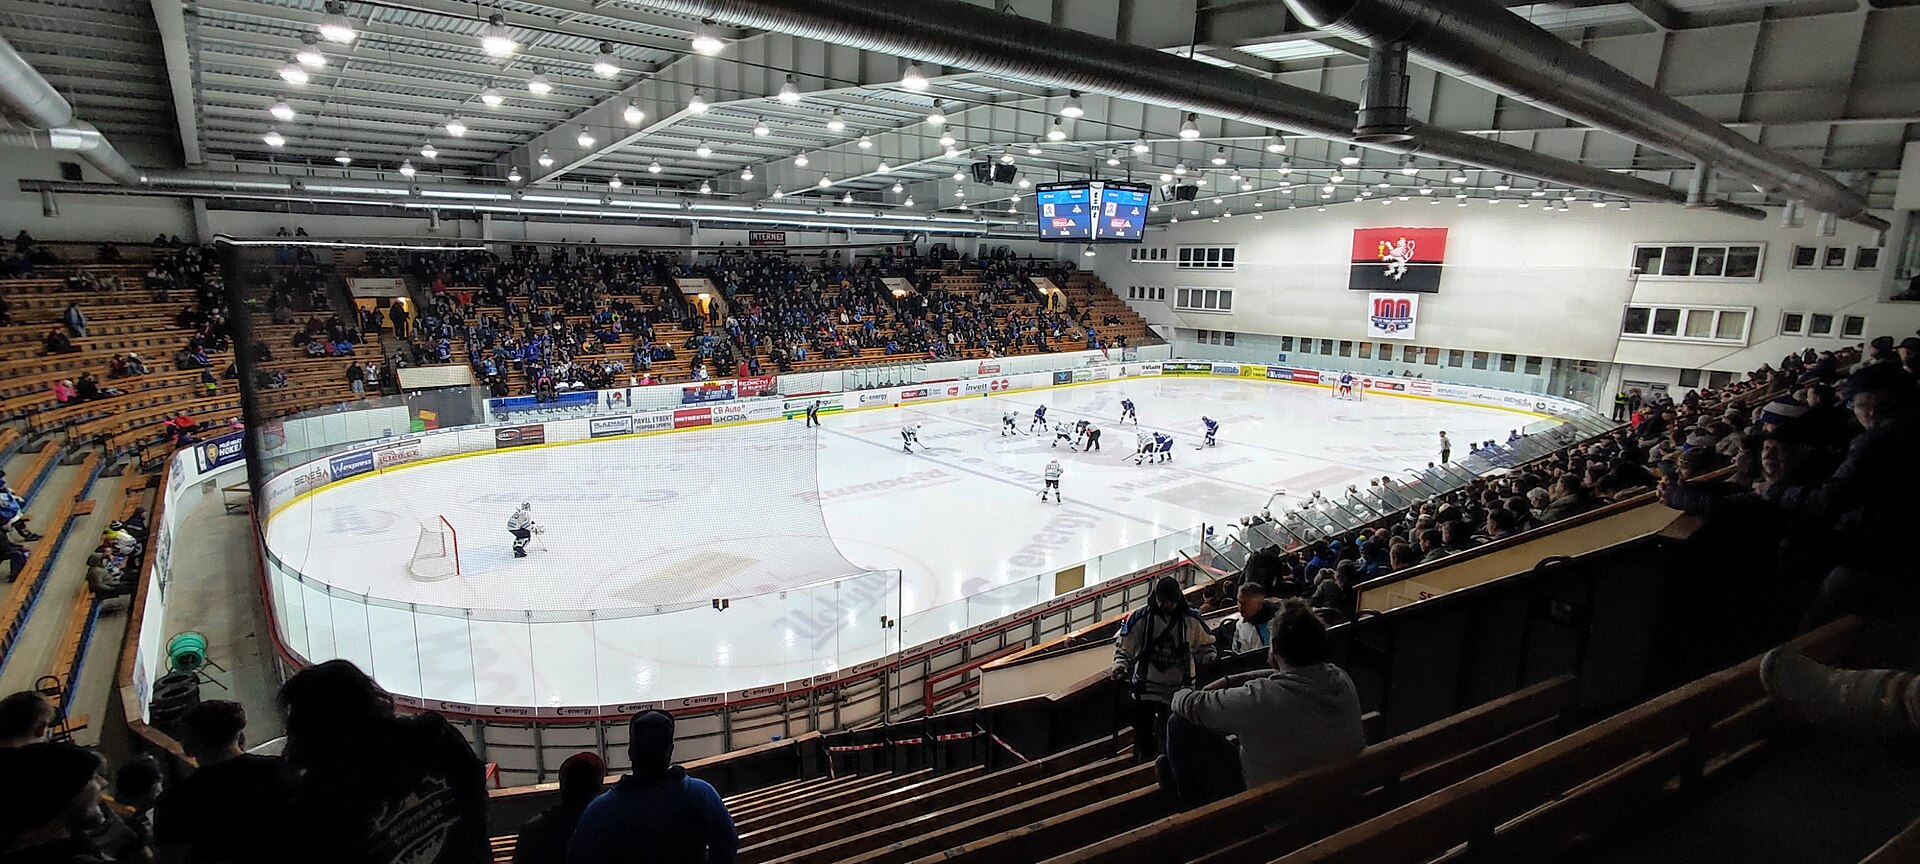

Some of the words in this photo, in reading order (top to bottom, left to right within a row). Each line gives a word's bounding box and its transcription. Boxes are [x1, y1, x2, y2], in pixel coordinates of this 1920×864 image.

[750, 232, 785, 241] INTERNET
[1374, 298, 1411, 318] 100
[634, 417, 651, 425] PAVEL
[219, 444, 242, 457] HOKEJ
